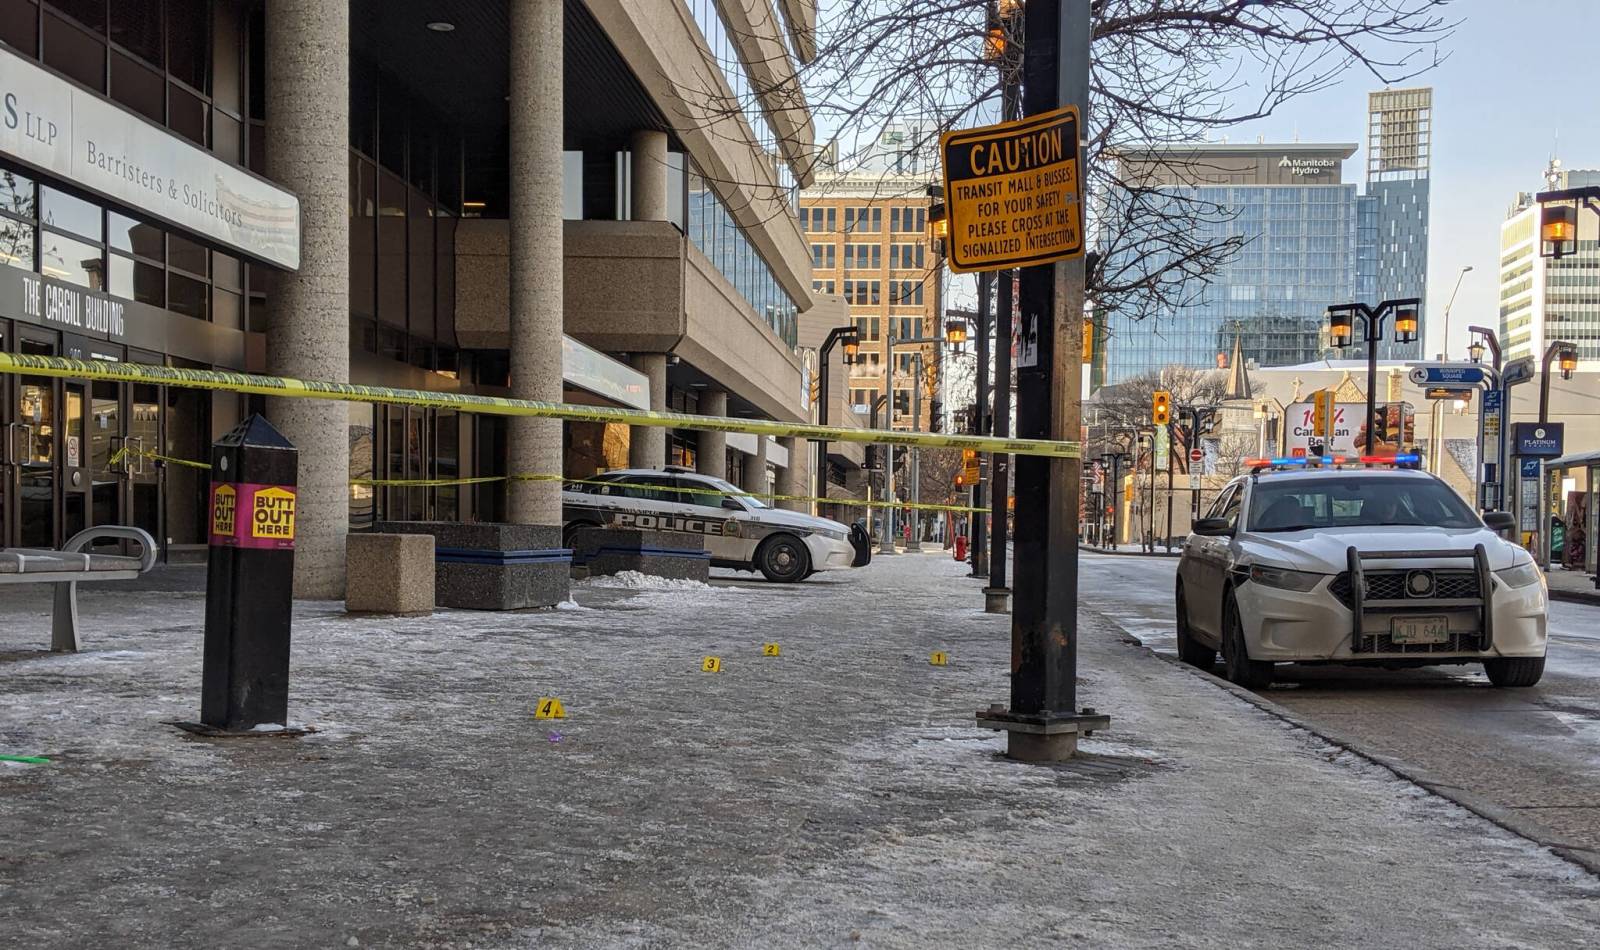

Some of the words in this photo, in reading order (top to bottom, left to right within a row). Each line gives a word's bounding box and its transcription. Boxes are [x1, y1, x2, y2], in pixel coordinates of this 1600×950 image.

[5, 93, 18, 129] S
[25, 112, 57, 146] LLP
[970, 128, 1062, 176] CAUTION
[1292, 167, 1320, 176] Hydro
[87, 140, 162, 194] Barristers
[168, 178, 178, 201] &
[183, 184, 243, 228] Solicitors
[957, 181, 1003, 200] TRANSIT
[1008, 177, 1034, 194] MALL
[1036, 175, 1042, 189] &
[978, 201, 1000, 217] FOR
[1004, 196, 1033, 215] YOUR
[1036, 190, 1061, 210] SAFETY
[968, 220, 1007, 239] PLEASE
[1012, 217, 1043, 232] CROSS
[1045, 213, 1054, 227] AT
[1055, 208, 1070, 225] THE
[962, 238, 1021, 258] SIGNALIZED
[1026, 227, 1076, 250] INTERSECTION
[23, 277, 41, 317] THE
[46, 284, 81, 327] CARGILL
[86, 296, 124, 337] BUILDING
[1294, 427, 1349, 437] Canan
[1308, 436, 1335, 446] Bef
[215, 493, 235, 505] BUTT
[256, 496, 294, 509] BUTT
[215, 506, 234, 521] OUT
[255, 508, 293, 525] OUT
[215, 521, 232, 532] HERE
[257, 525, 290, 535] HERE
[614, 513, 722, 535] POLICE
[767, 645, 774, 653] 2
[707, 659, 715, 668] 3
[935, 653, 941, 662] 1
[542, 700, 552, 716] 4
